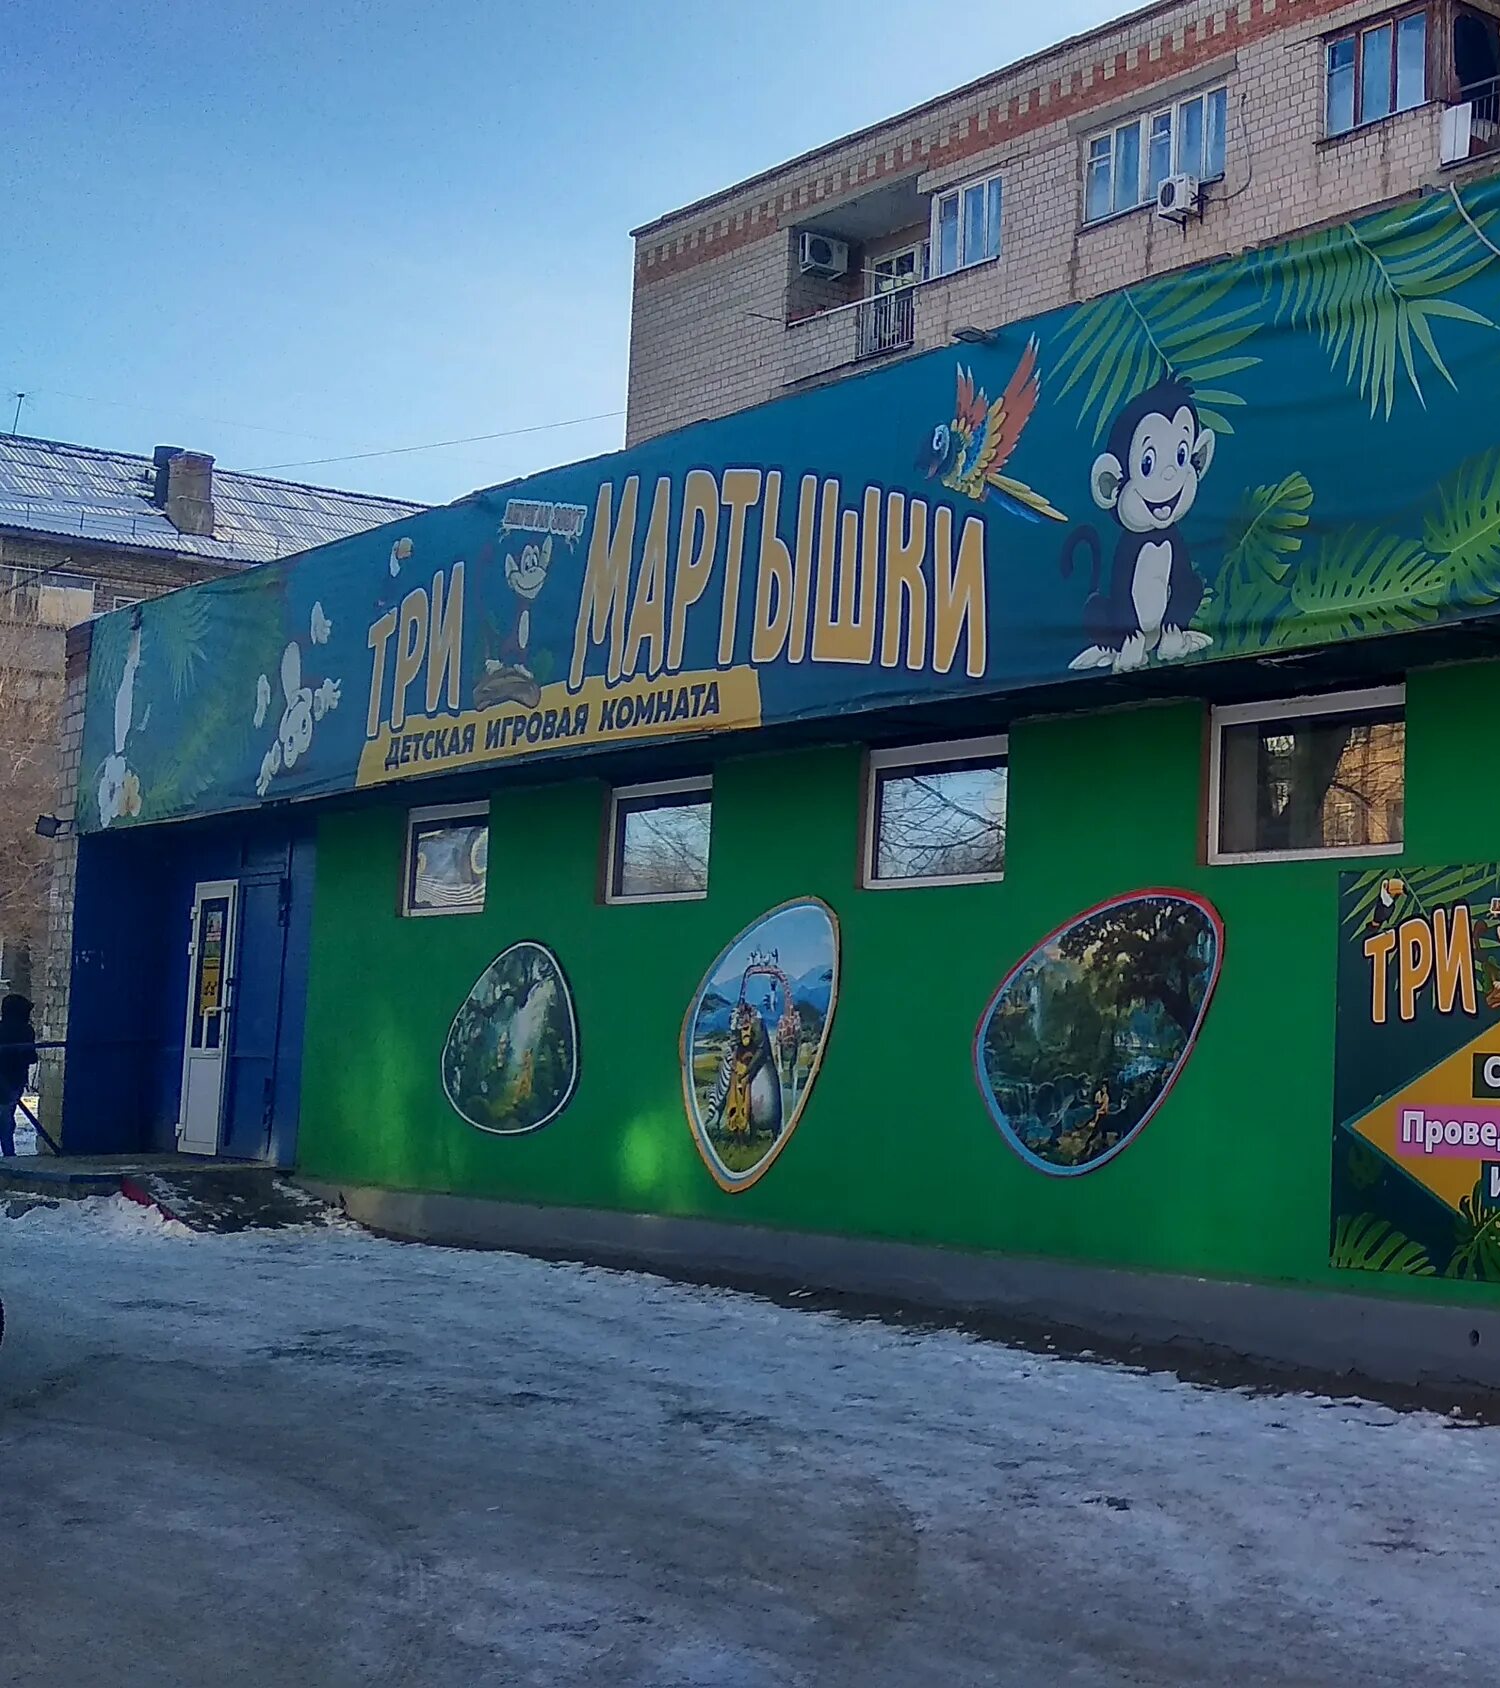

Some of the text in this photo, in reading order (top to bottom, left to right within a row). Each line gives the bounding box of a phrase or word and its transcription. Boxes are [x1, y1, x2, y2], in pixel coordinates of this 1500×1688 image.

[366, 468, 988, 740] ТРИ МАРТЫШКИ
[384, 681, 720, 771] ДЕТСКАЯ ИГРОВАЯ КОМНАТА
[1363, 903, 1478, 1025] ТРИ
